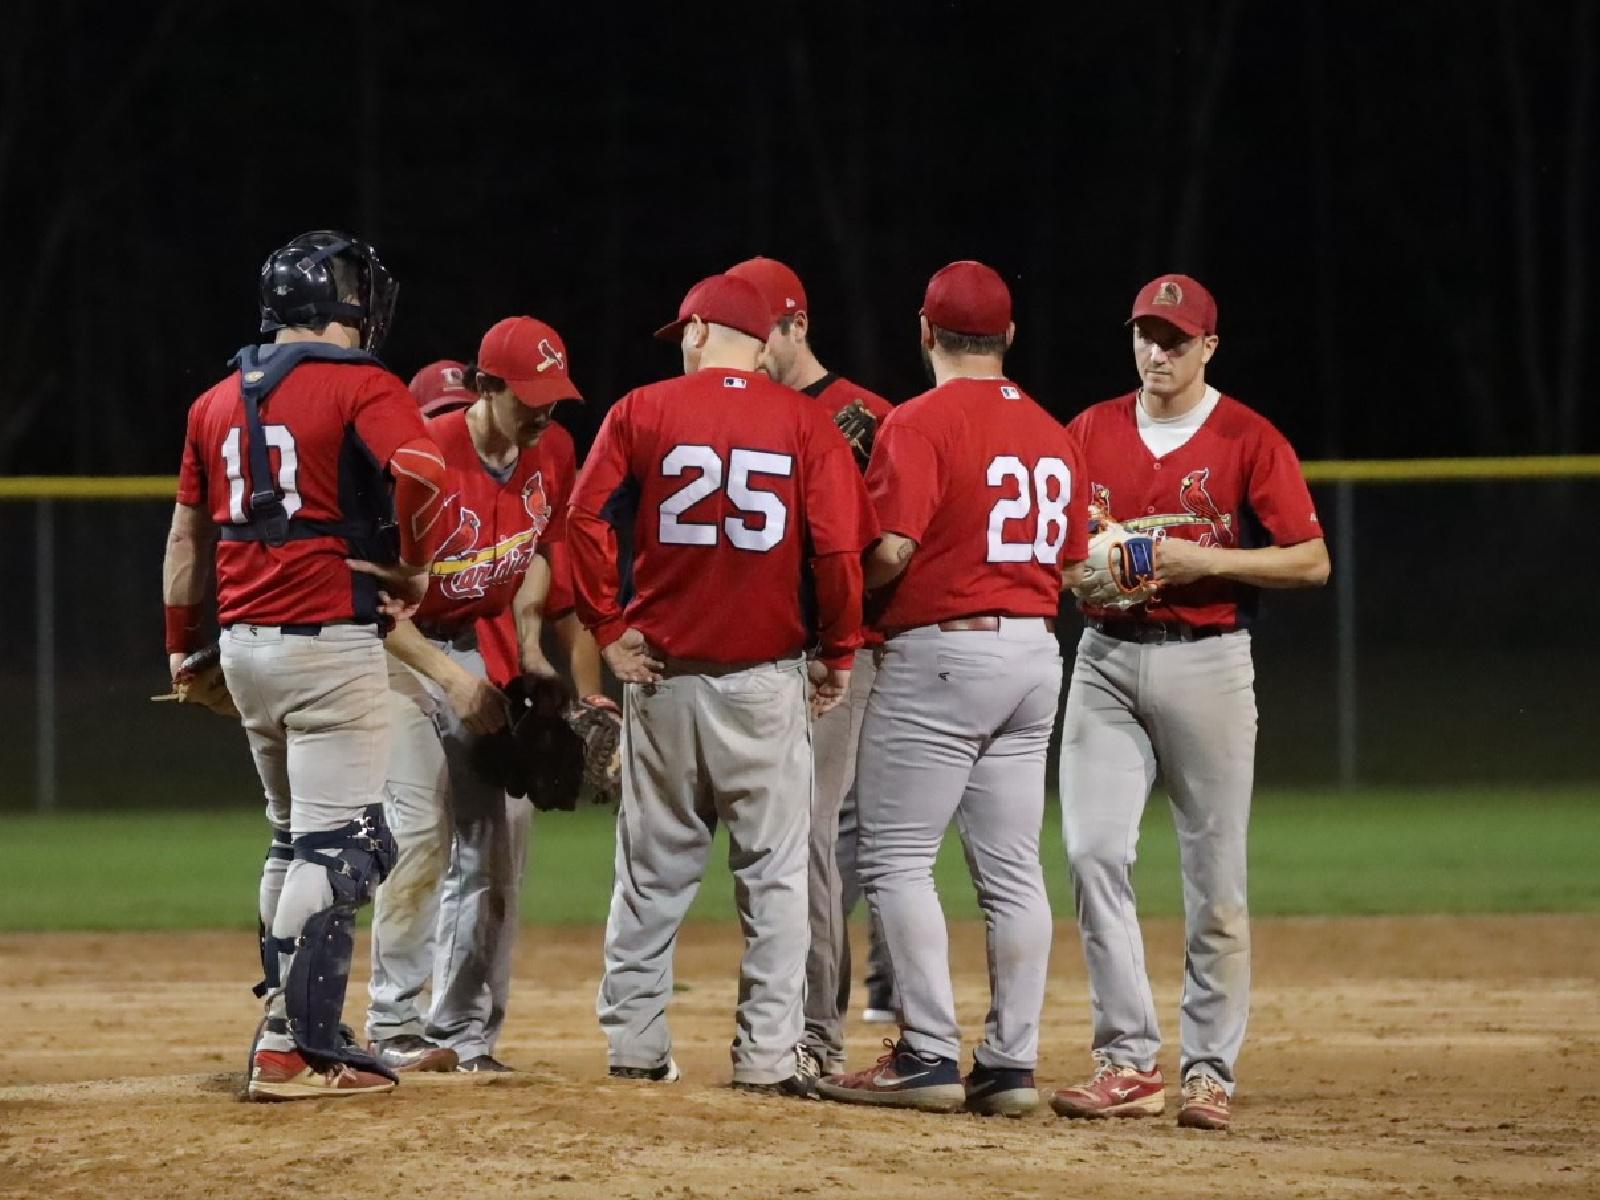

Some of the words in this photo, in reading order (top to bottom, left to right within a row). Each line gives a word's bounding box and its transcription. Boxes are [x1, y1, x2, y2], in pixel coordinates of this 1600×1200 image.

[221, 425, 302, 524] 10
[658, 444, 793, 552] 25
[985, 455, 1072, 564] 28
